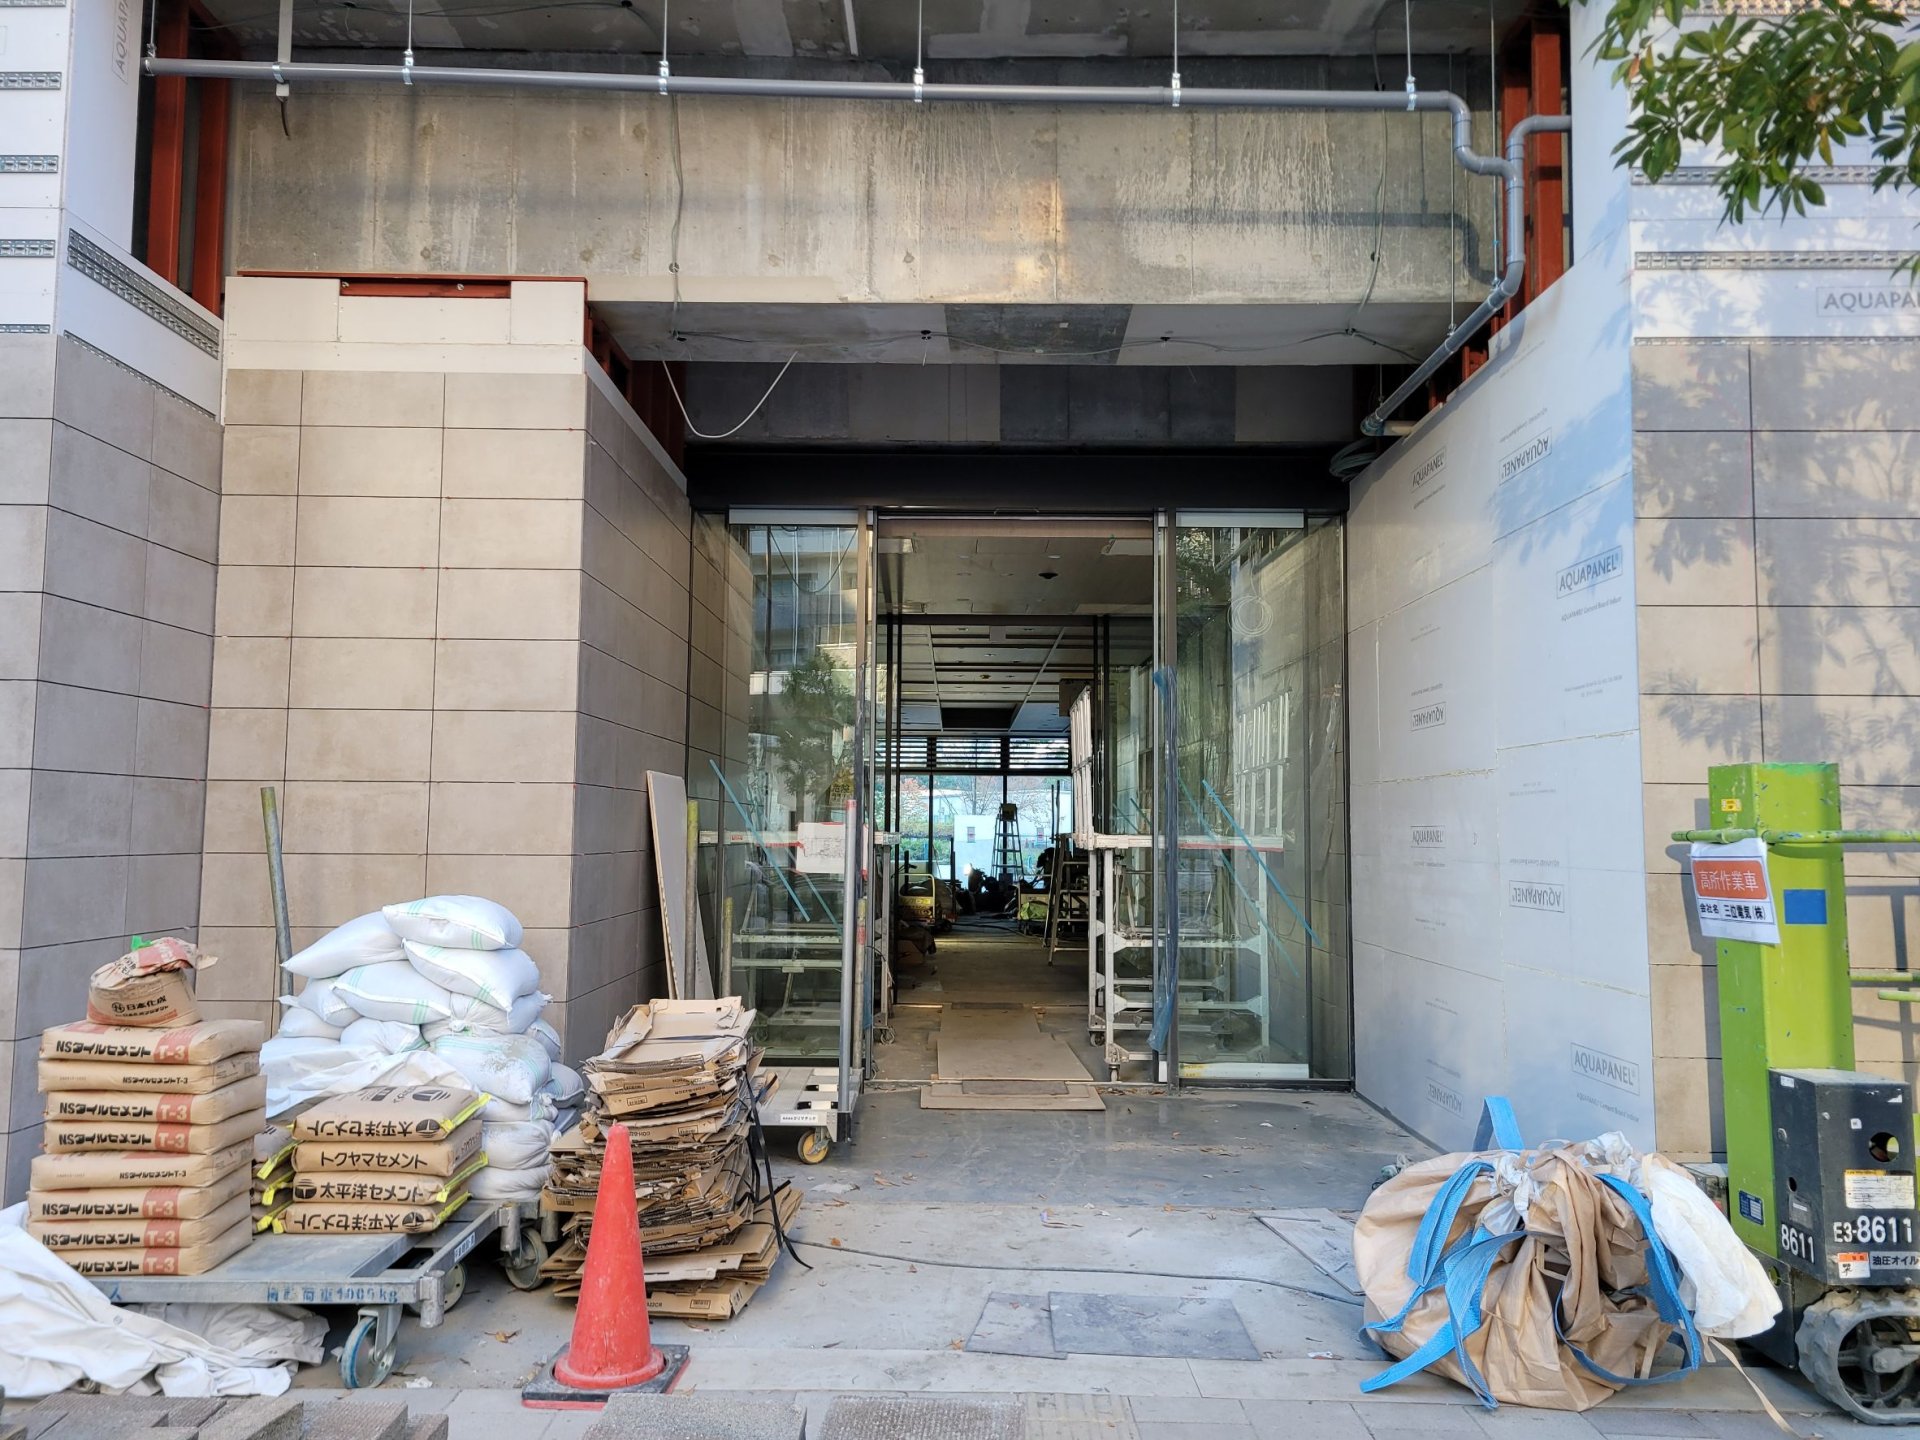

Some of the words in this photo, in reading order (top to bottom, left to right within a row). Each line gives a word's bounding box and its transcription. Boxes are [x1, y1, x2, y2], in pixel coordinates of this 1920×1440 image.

[1823, 291, 1920, 313] AQUAPA
[1558, 555, 1618, 592] AQUAPANEL
[1698, 870, 1759, 892] 高所作業車
[158, 1043, 185, 1060] T-3
[1574, 1049, 1634, 1086] AQUAPANEL
[160, 1104, 188, 1120] T-3
[306, 1120, 413, 1137] 太平洋セメント
[158, 1136, 187, 1149] T-3
[321, 1151, 428, 1169] トクヤマセメント
[320, 1182, 424, 1203] 太平洋セメント
[146, 1200, 176, 1214] T-3
[293, 1213, 401, 1231] 太平洋セメント
[1832, 1215, 1913, 1244] E3-8611
[147, 1230, 177, 1245] T-3
[1781, 1223, 1815, 1264] 8611
[146, 1257, 175, 1272] T-3
[1872, 1255, 1919, 1267] 油圧オイル
